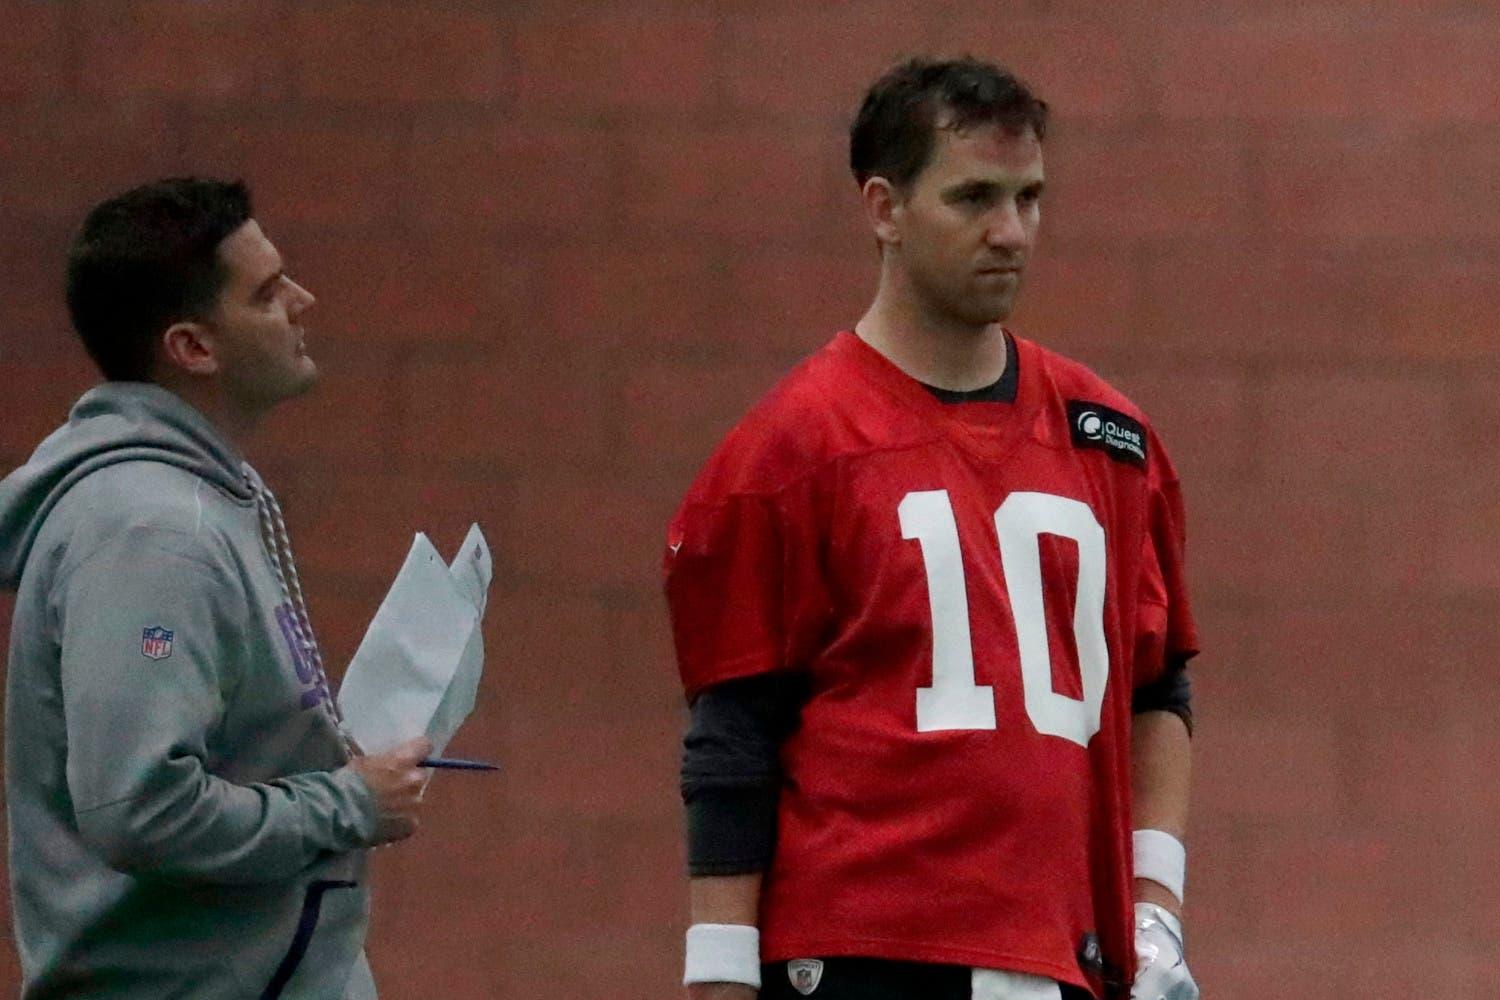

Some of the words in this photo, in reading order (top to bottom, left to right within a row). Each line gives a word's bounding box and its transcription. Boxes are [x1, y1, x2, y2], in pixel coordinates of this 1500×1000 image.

[1105, 421, 1141, 446] Quest
[1105, 434, 1146, 460] Diagno
[897, 489, 1109, 749] 10
[144, 639, 170, 656] NFL
